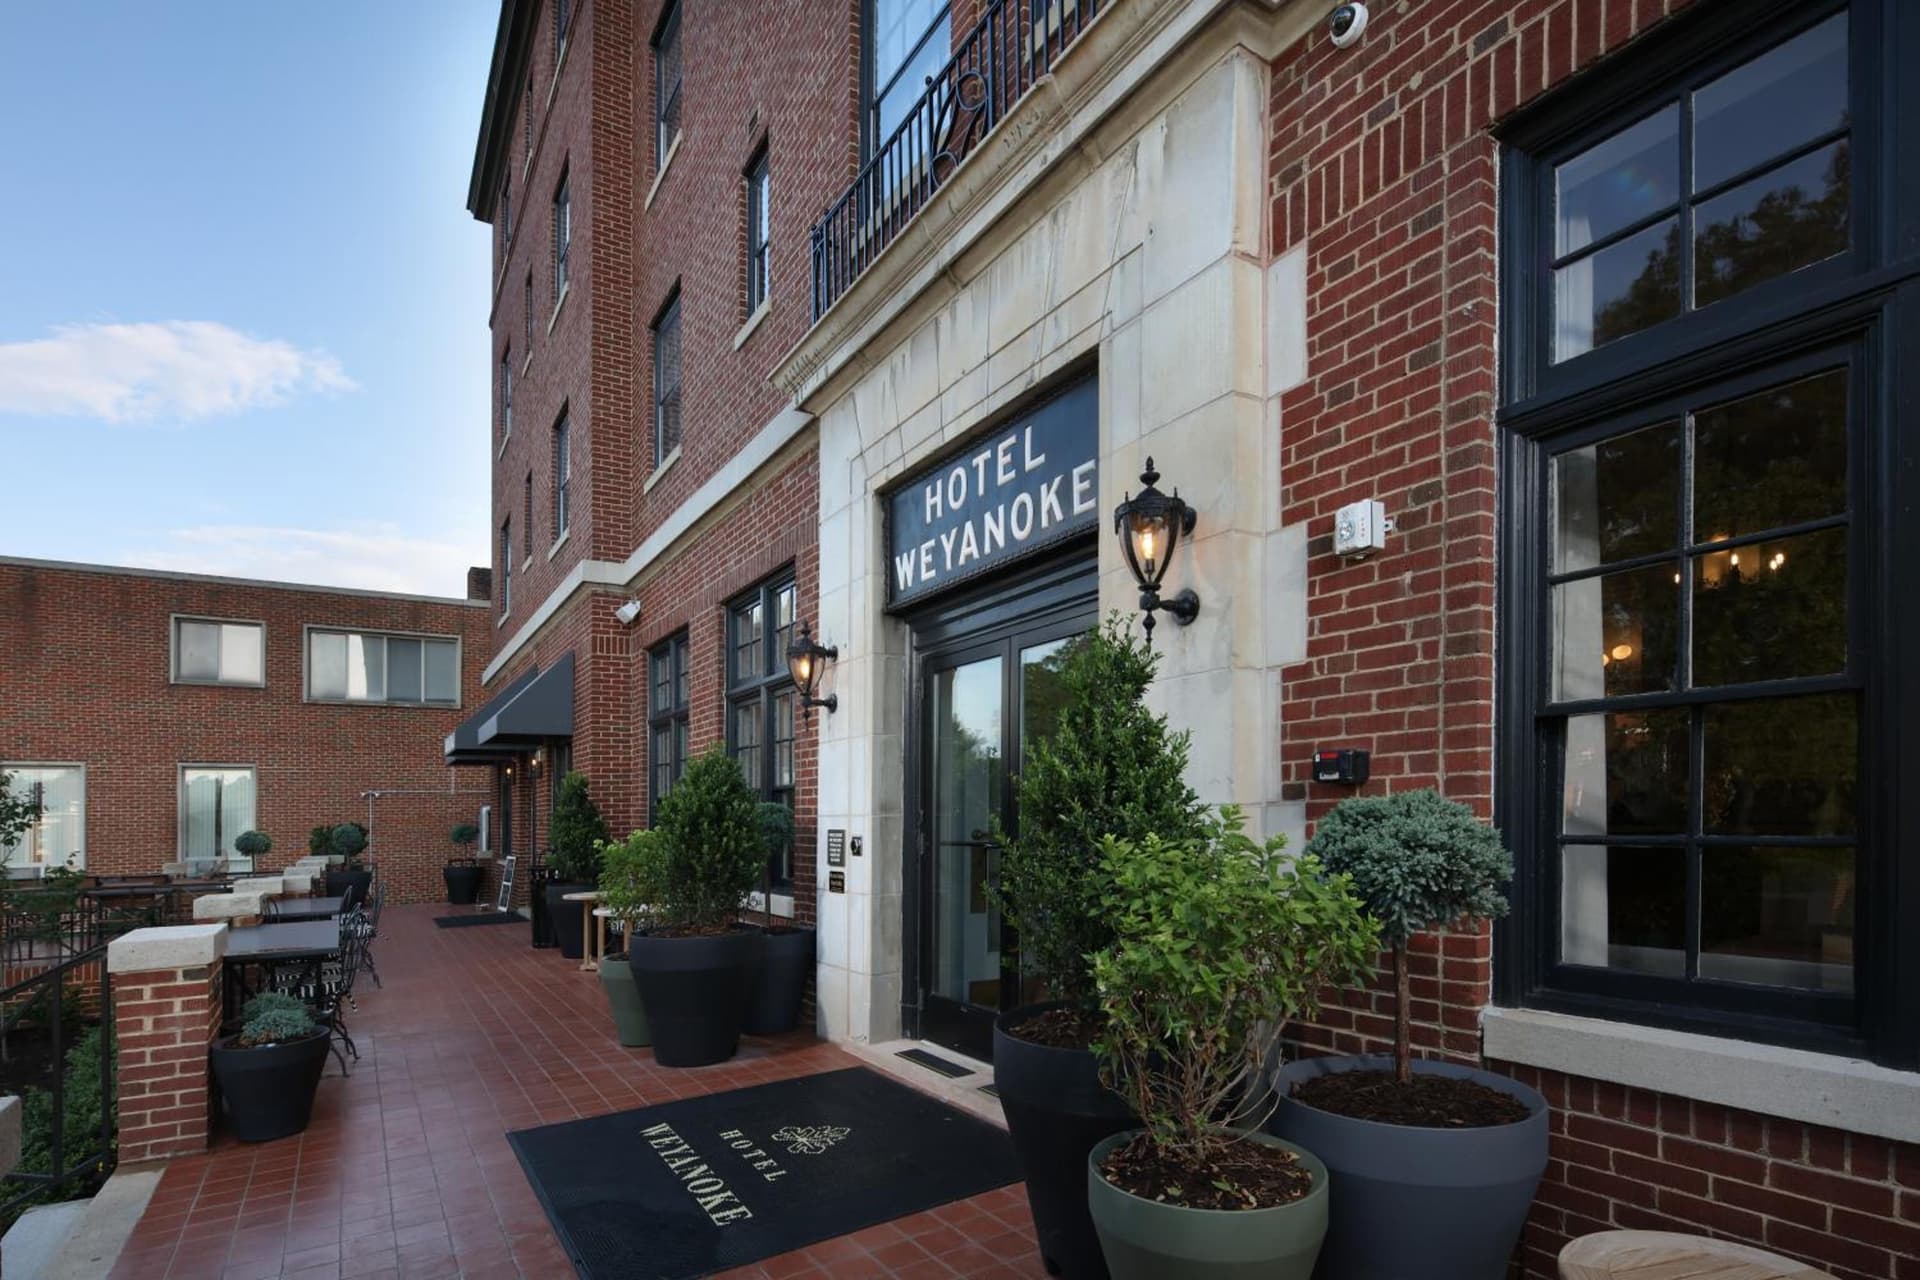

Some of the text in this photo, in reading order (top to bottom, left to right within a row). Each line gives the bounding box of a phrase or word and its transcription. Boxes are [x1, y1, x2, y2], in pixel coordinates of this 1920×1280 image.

[895, 459, 1097, 591] WEYANOKE
[925, 426, 1046, 524] HOTEL
[639, 1122, 753, 1227] WEYANOKE
[719, 1129, 787, 1182] HOTEL
